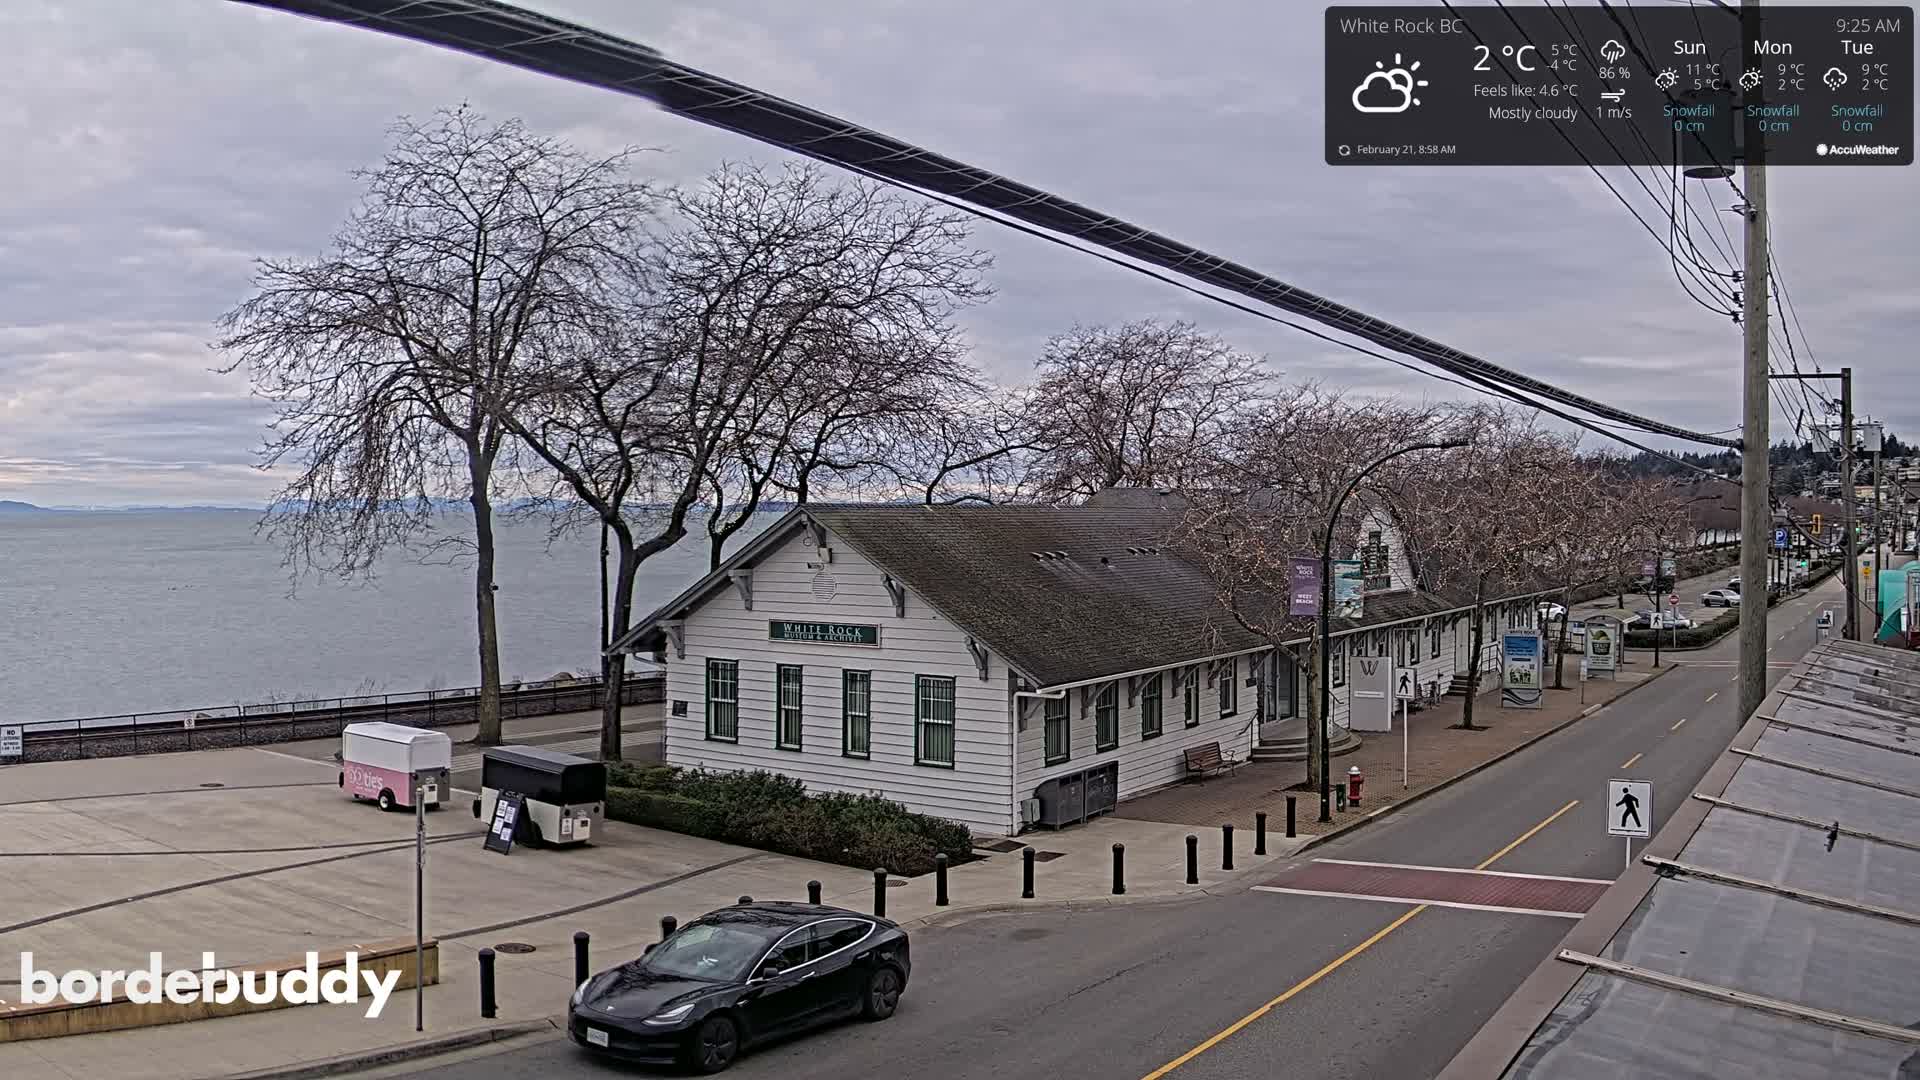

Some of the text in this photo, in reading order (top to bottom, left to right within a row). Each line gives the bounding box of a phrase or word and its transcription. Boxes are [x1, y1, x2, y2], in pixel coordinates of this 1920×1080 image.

[783, 623, 861, 637] WHITE ROCK
[784, 632, 814, 640] MUSEUM
[824, 634, 862, 643] ARCHIVES
